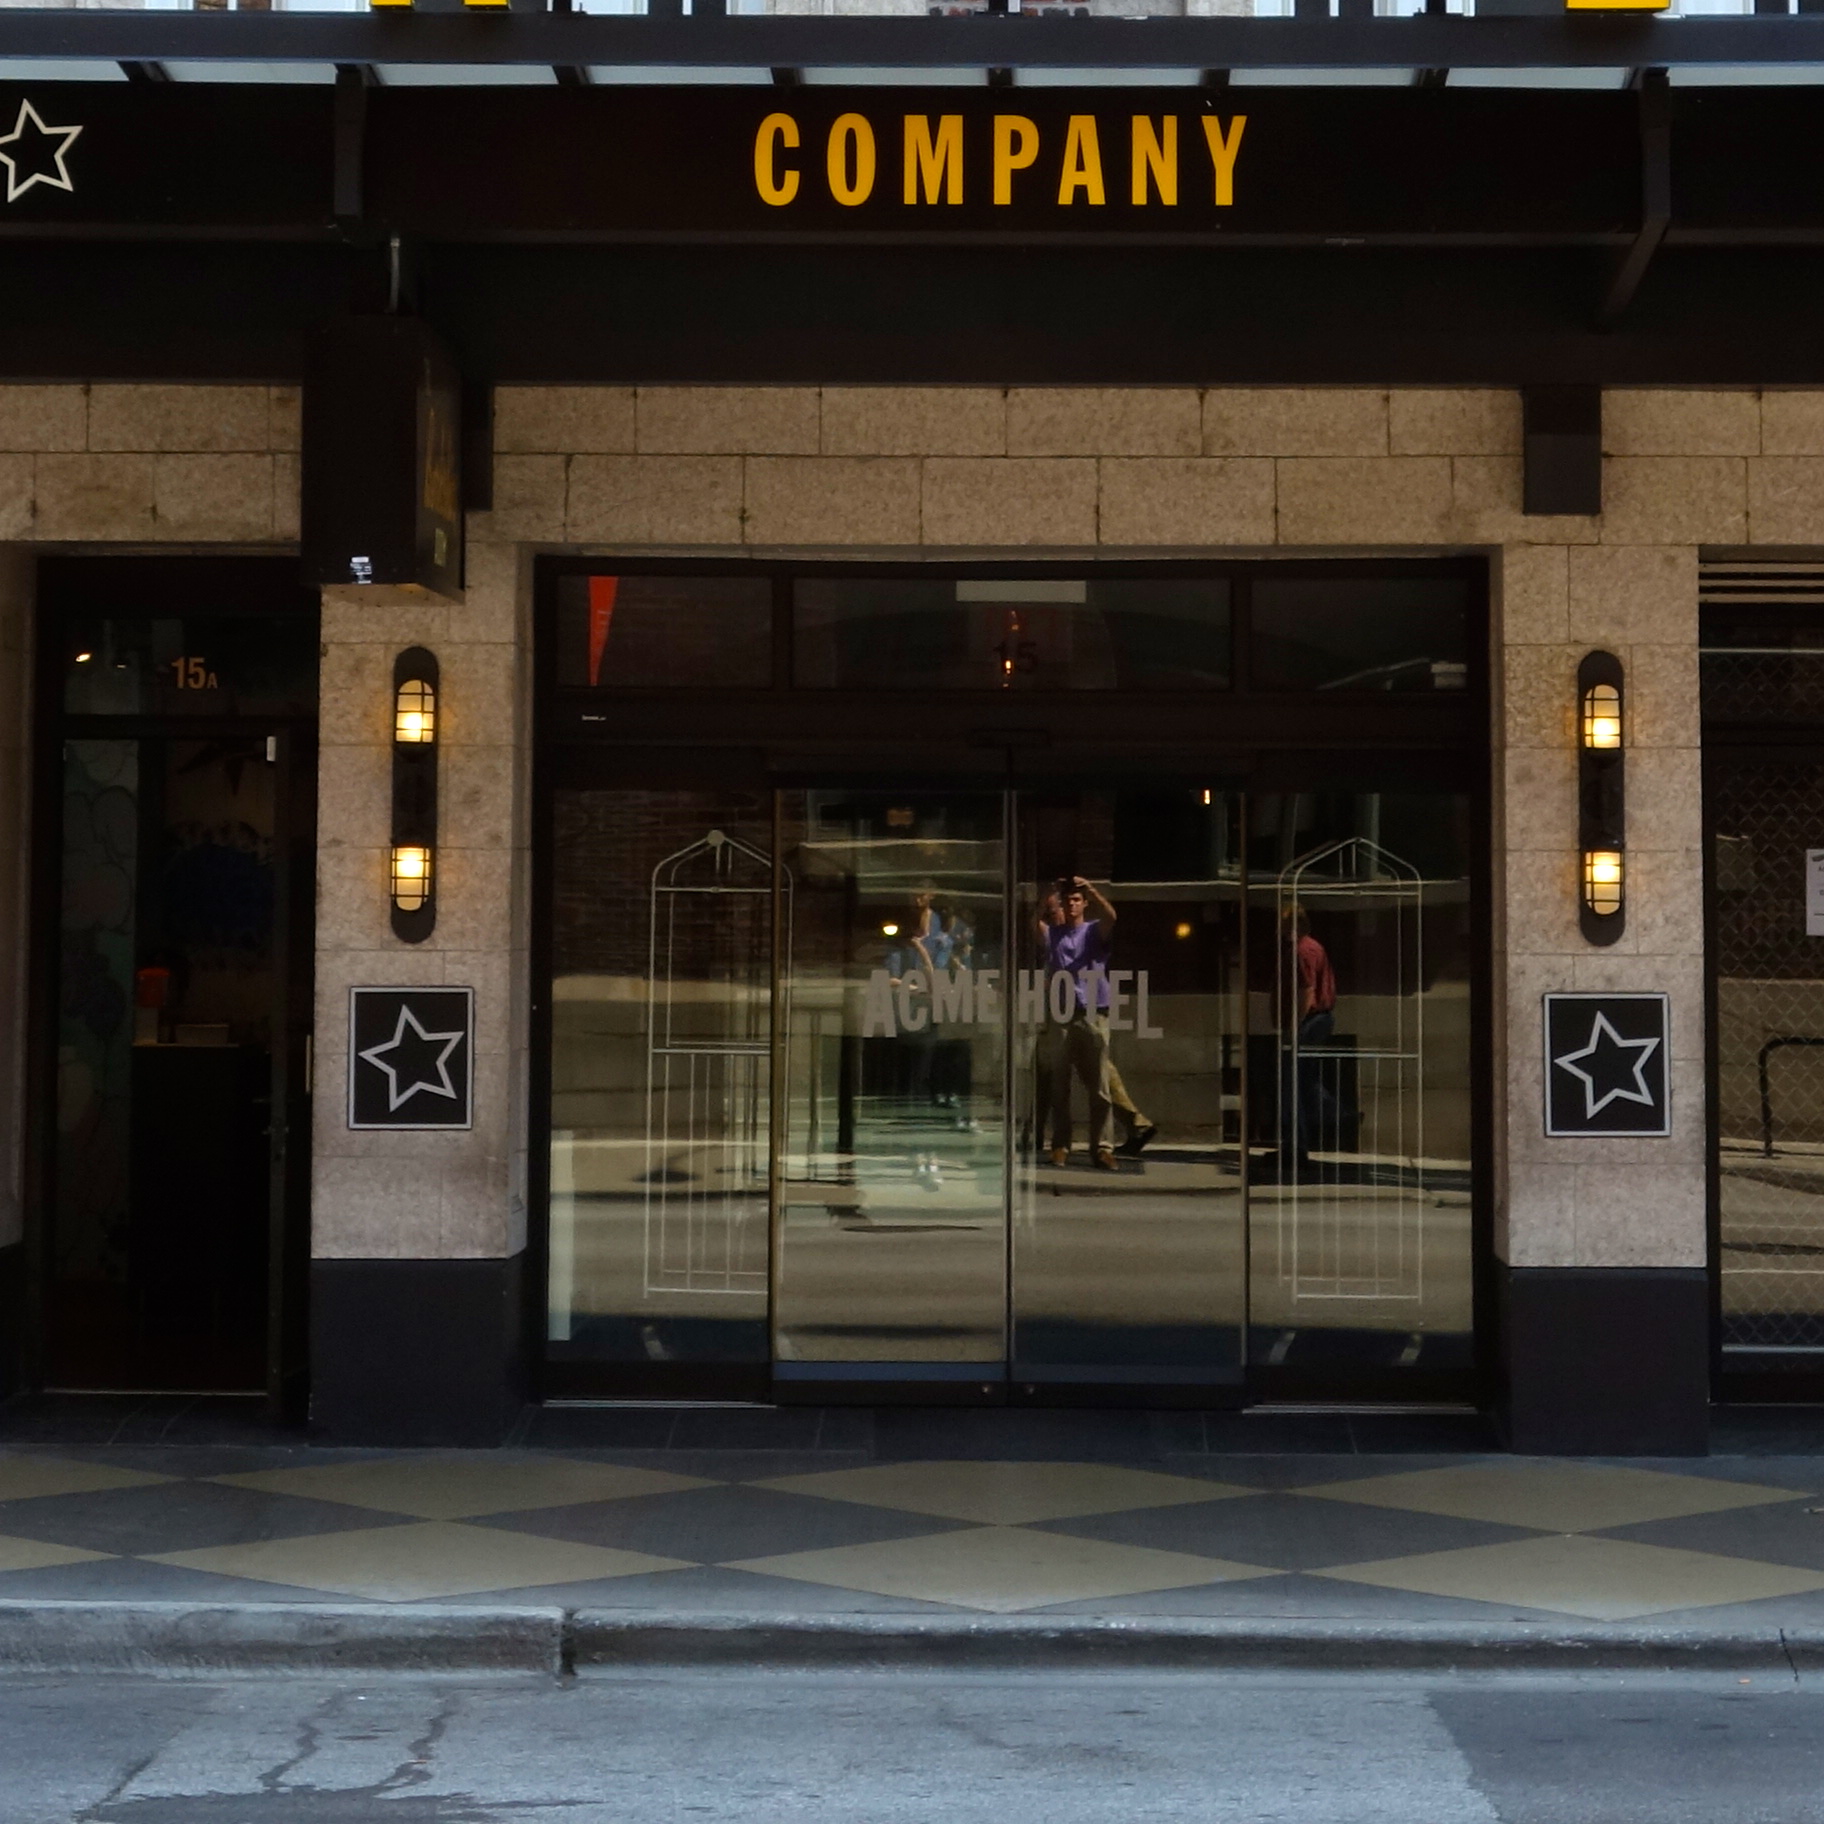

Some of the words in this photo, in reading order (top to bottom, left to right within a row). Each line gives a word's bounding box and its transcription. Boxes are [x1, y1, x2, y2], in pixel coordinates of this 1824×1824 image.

[754, 112, 1247, 207] COMPANY
[862, 969, 1000, 1039] ACME
[1018, 969, 1164, 1039] HOTEL
